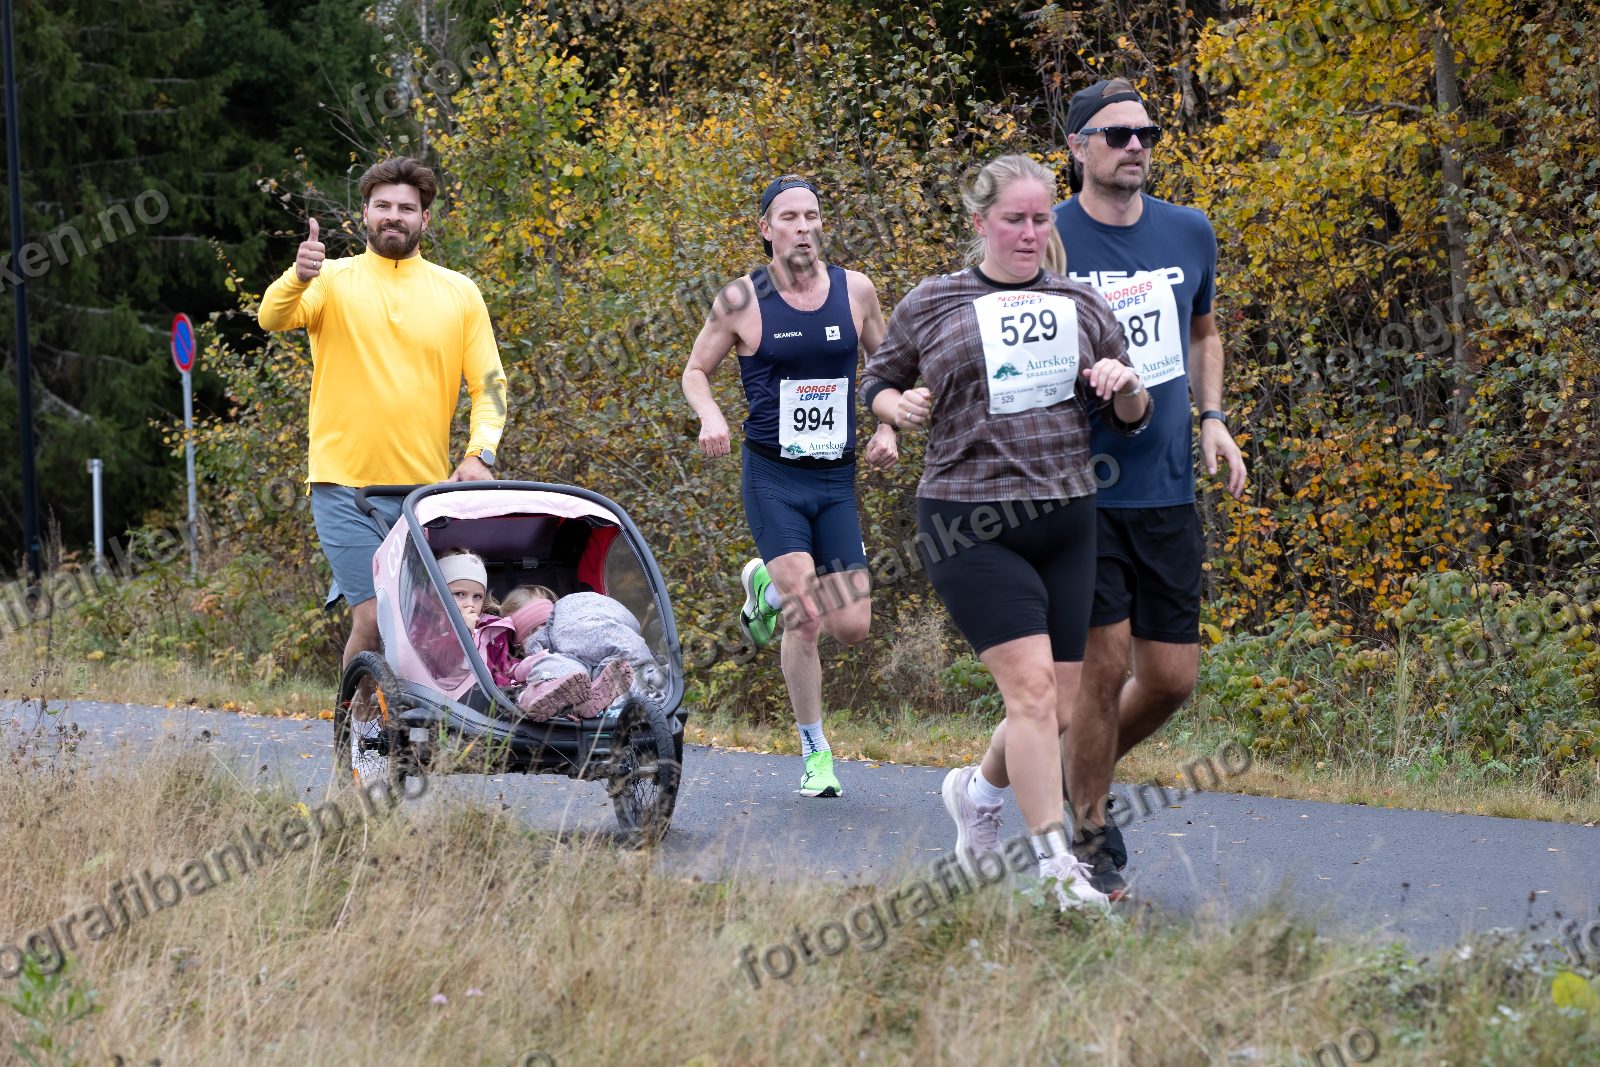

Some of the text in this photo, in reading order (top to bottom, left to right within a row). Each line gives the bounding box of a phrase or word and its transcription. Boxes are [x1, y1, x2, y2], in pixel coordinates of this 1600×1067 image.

[1104, 281, 1153, 301] NORGES
[998, 293, 1043, 302] NORG
[1111, 293, 1148, 312] LØPET
[1001, 309, 1058, 346] 529
[774, 331, 803, 339] SKANSKA
[1026, 355, 1076, 371] Aurskog
[1140, 354, 1180, 374] Aurskog
[796, 384, 837, 394] NORGES
[1044, 387, 1057, 397] 529
[800, 392, 831, 401] LØPET
[1001, 395, 1014, 404] 529
[793, 406, 835, 432] 994
[808, 441, 845, 453] Aurskog
